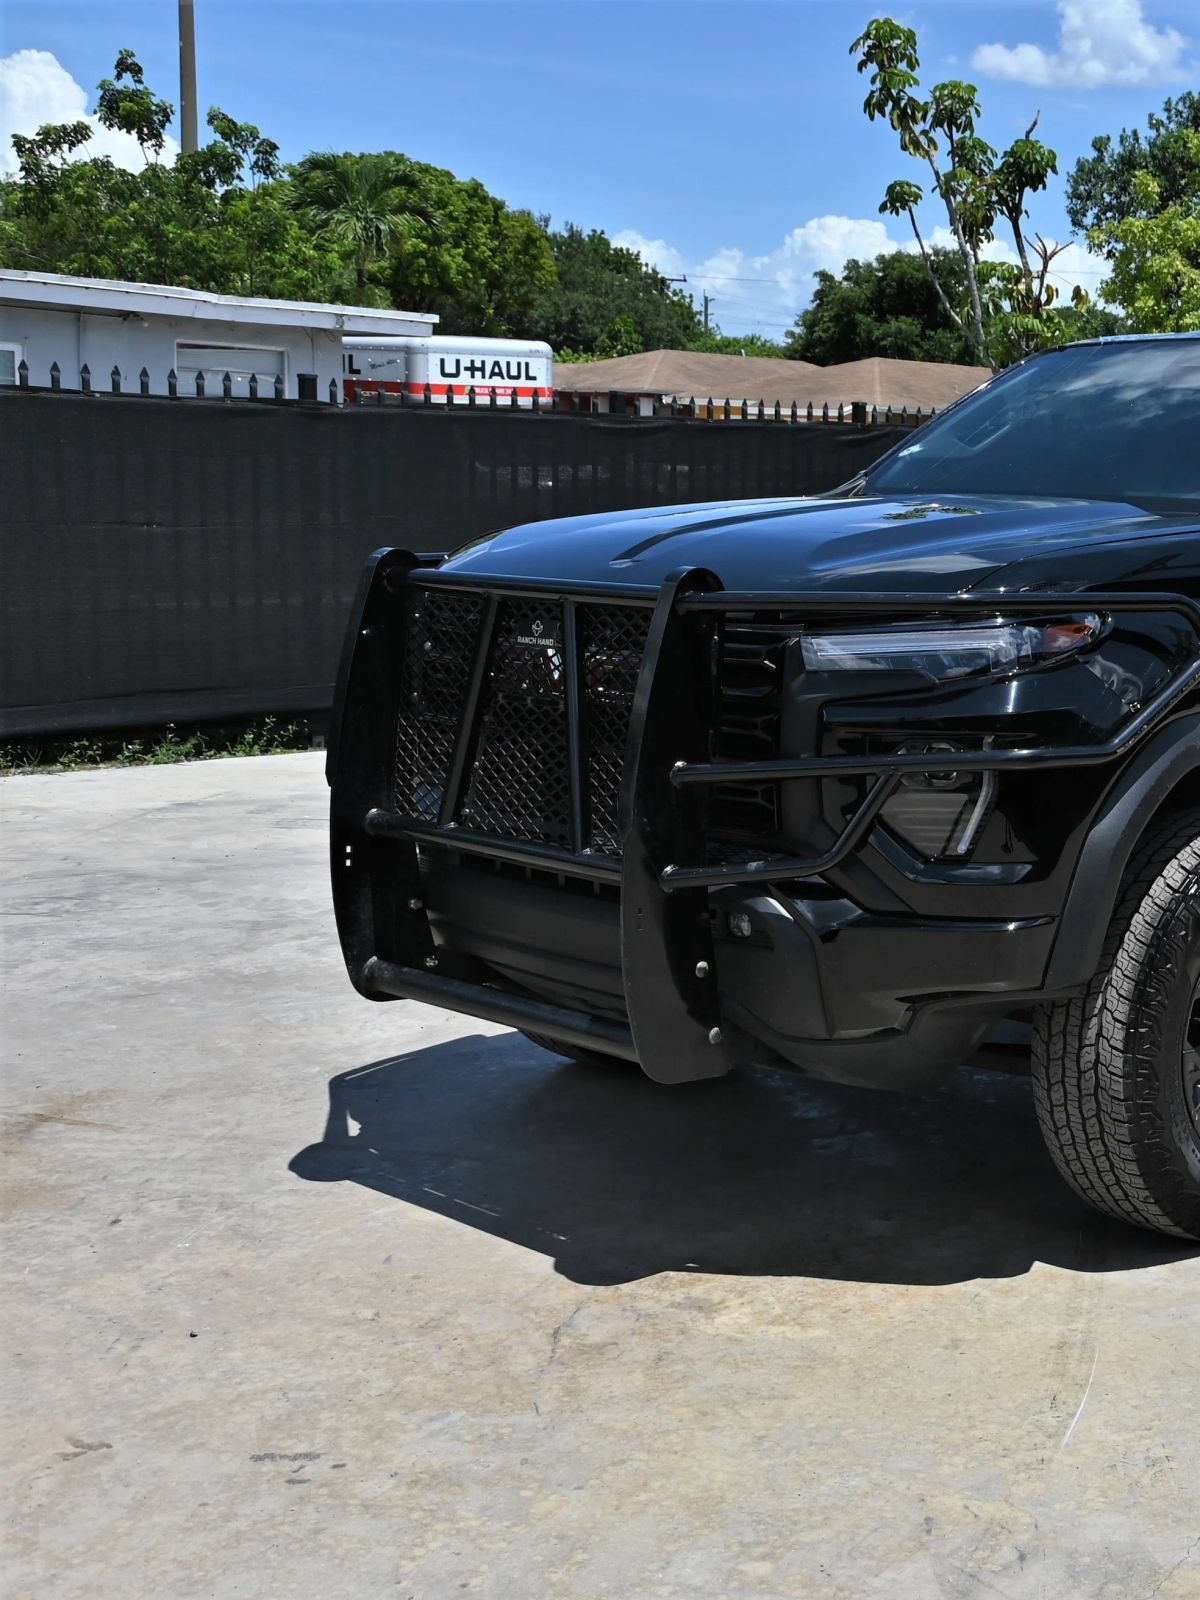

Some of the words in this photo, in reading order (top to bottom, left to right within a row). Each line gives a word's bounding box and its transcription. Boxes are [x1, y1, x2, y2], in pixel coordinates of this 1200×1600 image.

[439, 357, 538, 382] U-HAUL
[517, 635, 538, 645] RANCH
[538, 637, 555, 647] HAND
